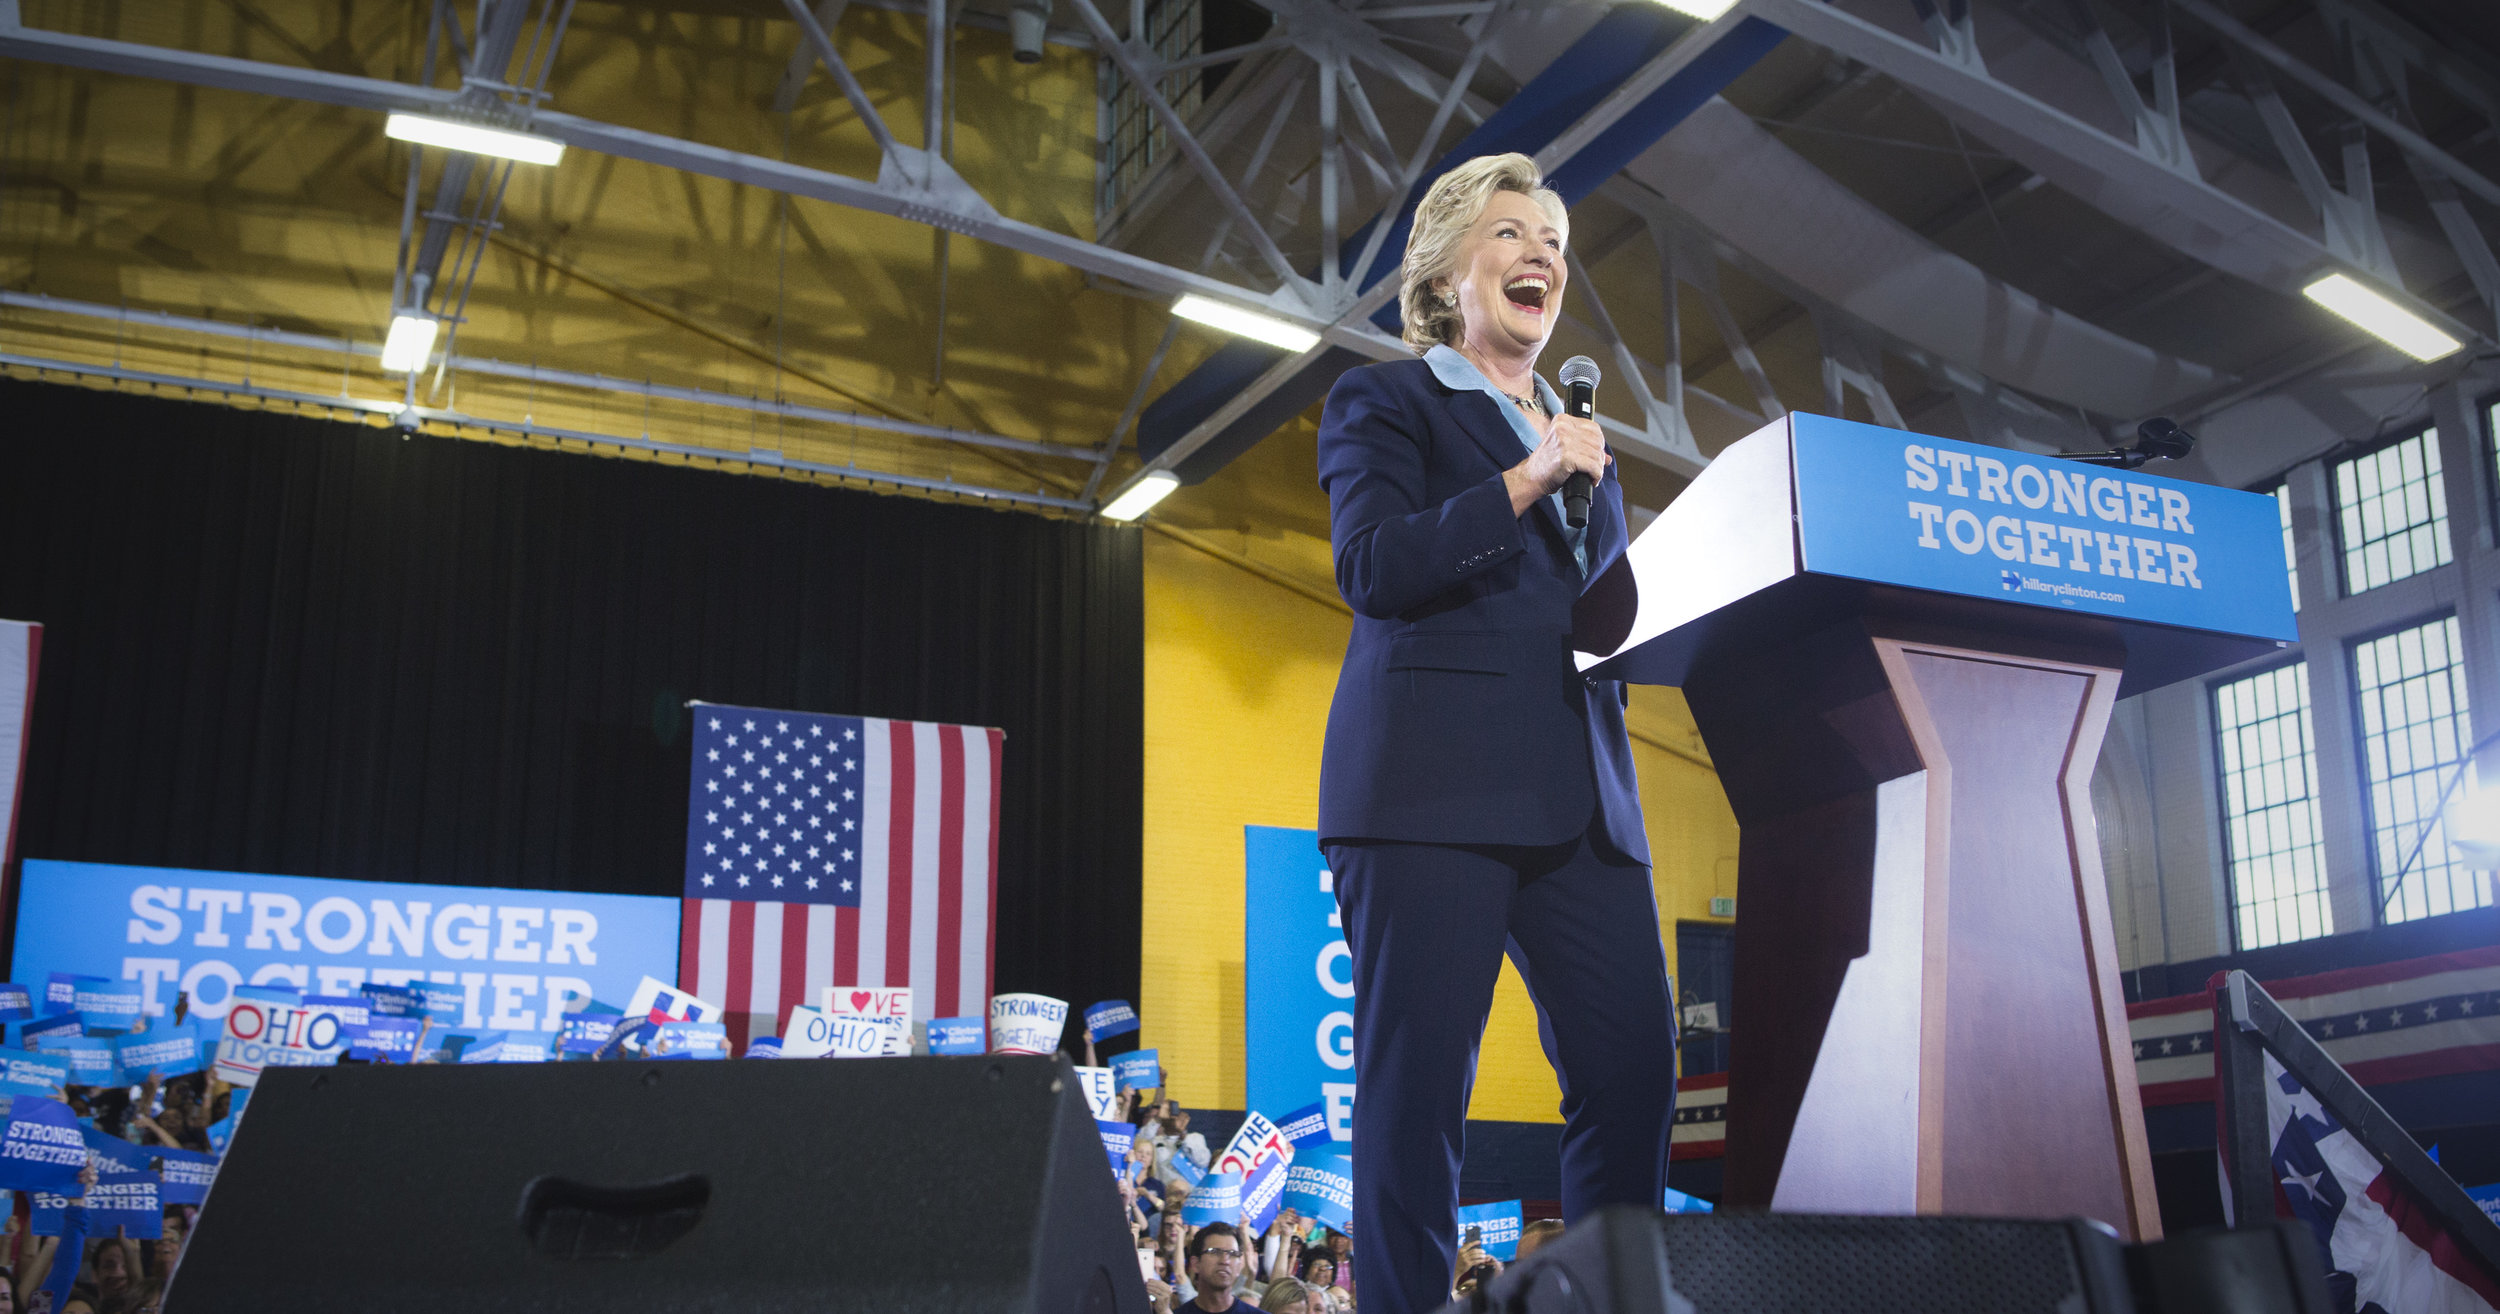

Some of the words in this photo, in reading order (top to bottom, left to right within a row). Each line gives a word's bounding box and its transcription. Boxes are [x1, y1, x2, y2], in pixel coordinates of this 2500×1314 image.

[1905, 444, 2195, 535] STRONGER
[1908, 501, 2203, 590] TOGETHER
[2022, 577, 2126, 604] hillaryclinton.com
[127, 885, 598, 966] STRONGER
[990, 999, 1067, 1022] STRONGER
[229, 1004, 340, 1051] OHIO
[807, 1017, 877, 1053] OHIO
[948, 1026, 983, 1036] Clinton
[949, 1034, 976, 1045] Kaine
[7, 1071, 53, 1087] Kaine
[9, 1060, 66, 1079] Clinton
[1124, 1059, 1156, 1071] Clinton
[1125, 1068, 1150, 1079] Kaine
[8, 1121, 84, 1147] STRONGE
[1230, 1116, 1271, 1159] THE
[1242, 1162, 1286, 1212] STRONGER
[1289, 1165, 1353, 1196] STRONGE
[35, 1194, 159, 1211] TOETHER
[1248, 1171, 1289, 1220] TOGETHER
[1285, 1180, 1353, 1211] TOGETHE
